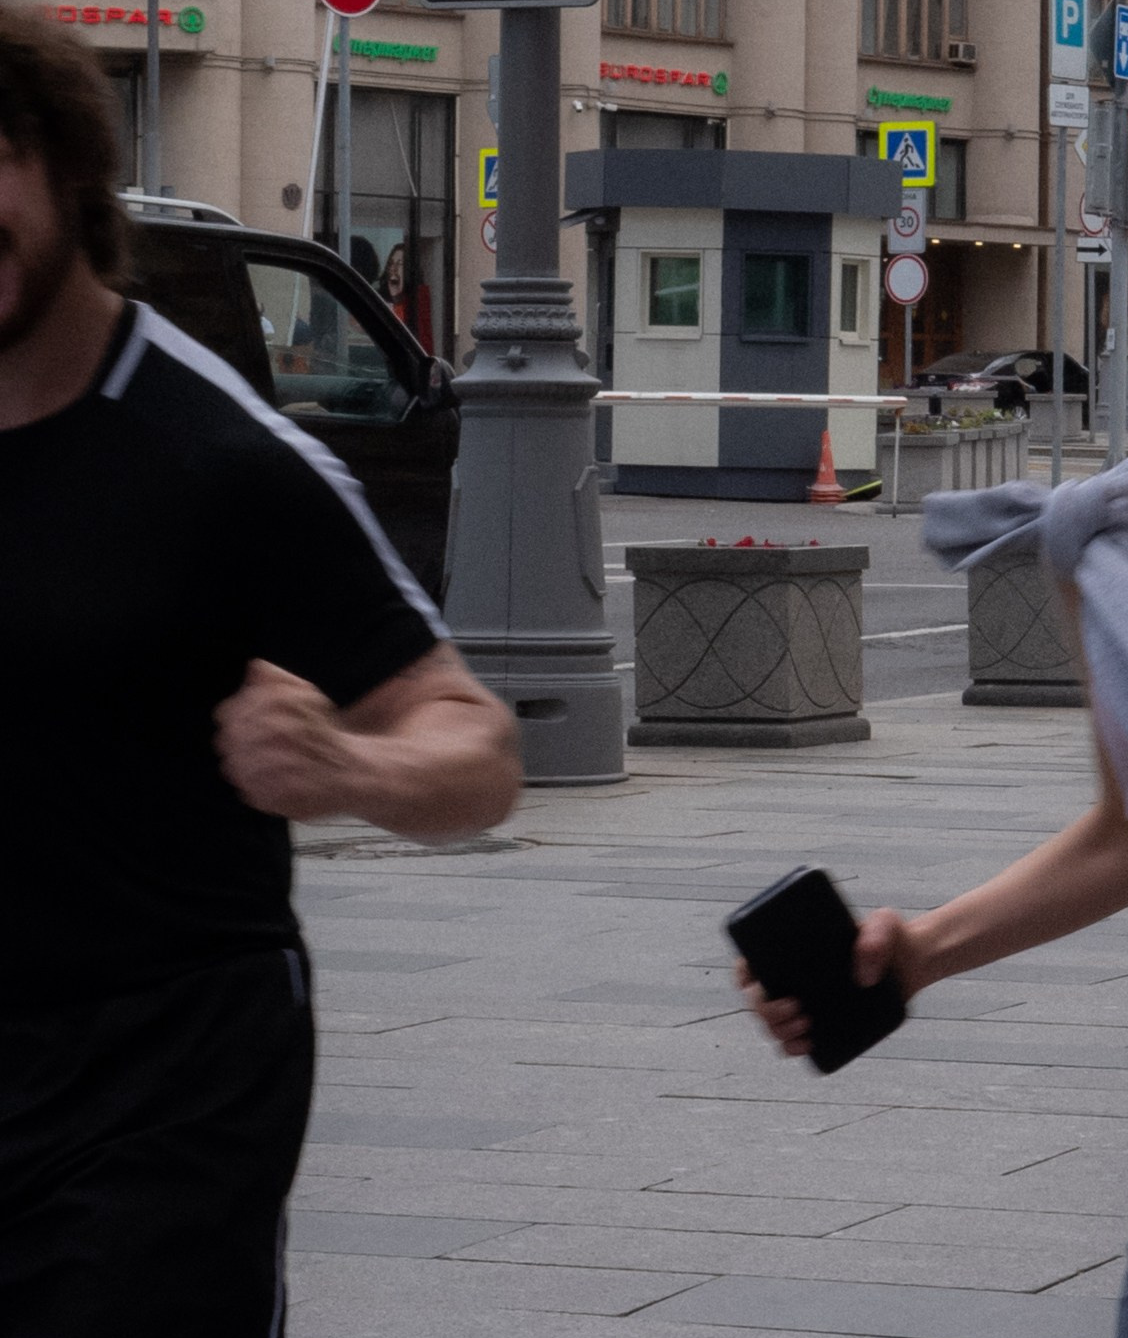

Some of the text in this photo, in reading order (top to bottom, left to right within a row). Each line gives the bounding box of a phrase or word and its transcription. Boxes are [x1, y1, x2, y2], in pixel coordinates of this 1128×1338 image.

[1062, 0, 1079, 38] P
[600, 62, 710, 86] EUROSPAR
[900, 216, 914, 228] 30
